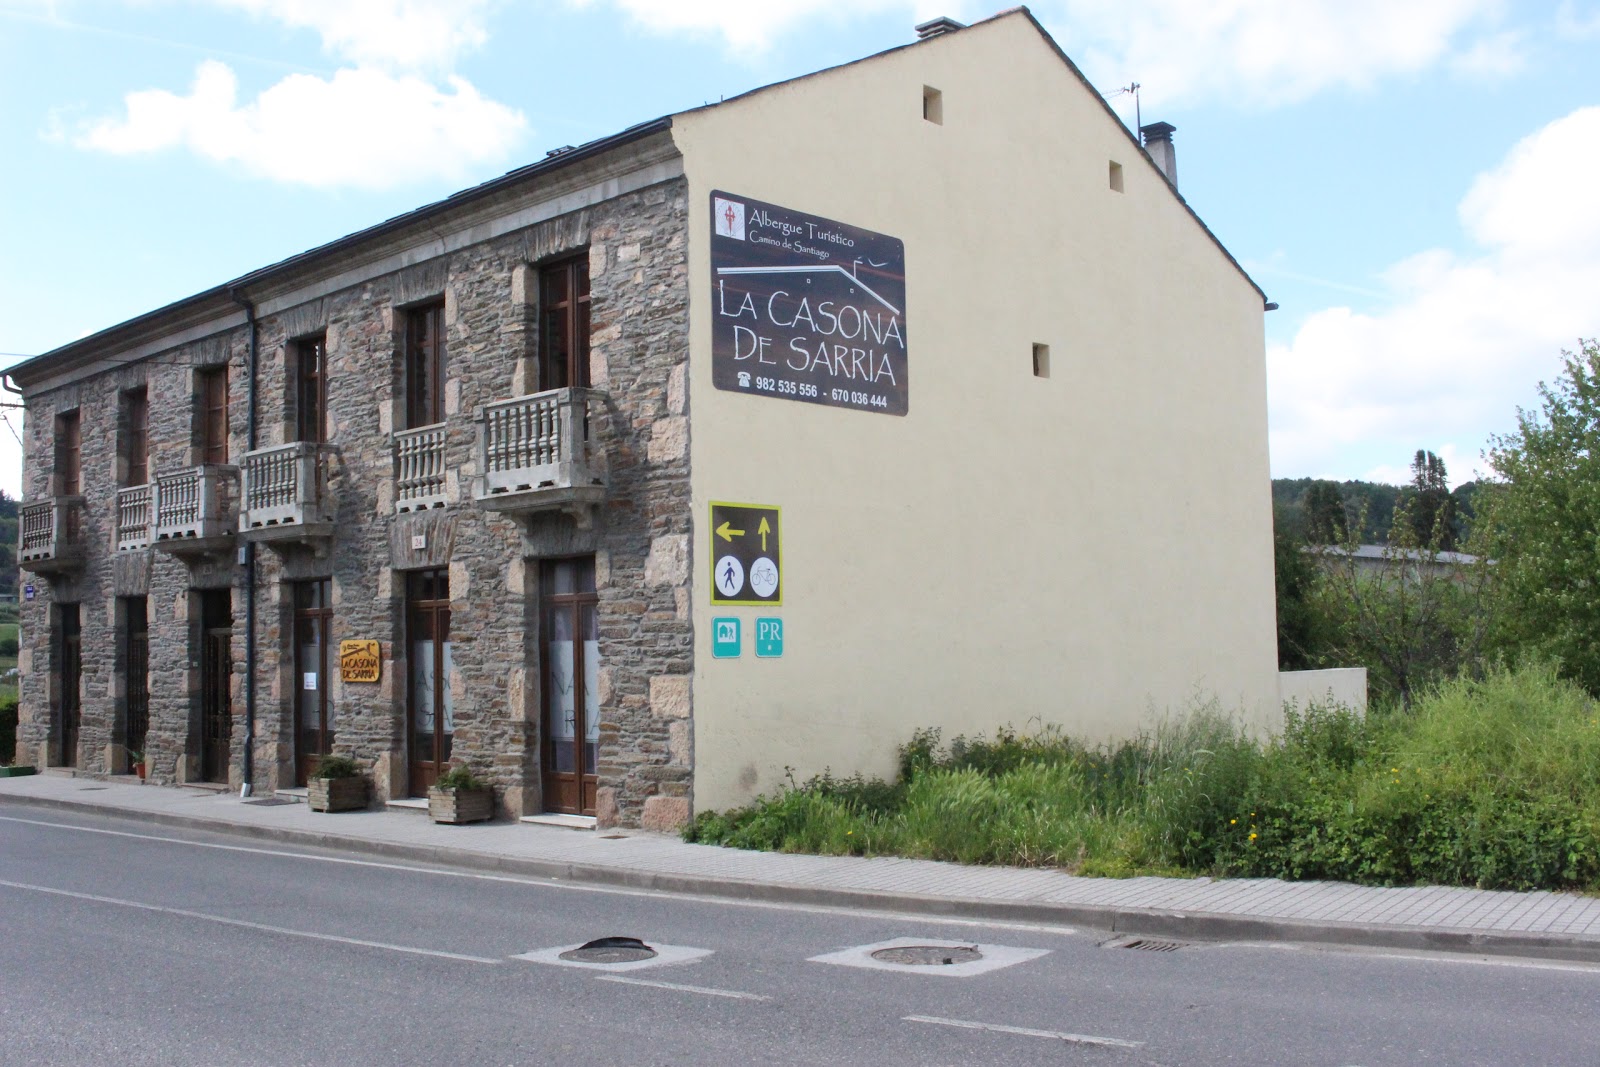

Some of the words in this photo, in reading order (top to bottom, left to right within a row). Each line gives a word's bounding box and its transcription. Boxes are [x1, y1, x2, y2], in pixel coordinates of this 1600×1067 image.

[748, 208, 803, 236] Albergue
[749, 230, 781, 247] Camino
[782, 238, 793, 250] de
[793, 240, 830, 260] Santiago
[719, 279, 758, 319] LA
[767, 290, 904, 349] CASONA
[733, 325, 777, 365] DE
[786, 336, 896, 386] SARRIA
[756, 376, 776, 391] 982
[778, 379, 797, 395] 535
[799, 383, 818, 398] 556
[831, 388, 849, 403] 670
[851, 391, 869, 406] 036
[870, 393, 888, 408] 444
[759, 621, 781, 640] PR
[348, 658, 378, 669] CASONA
[351, 669, 376, 680] SARRIA
